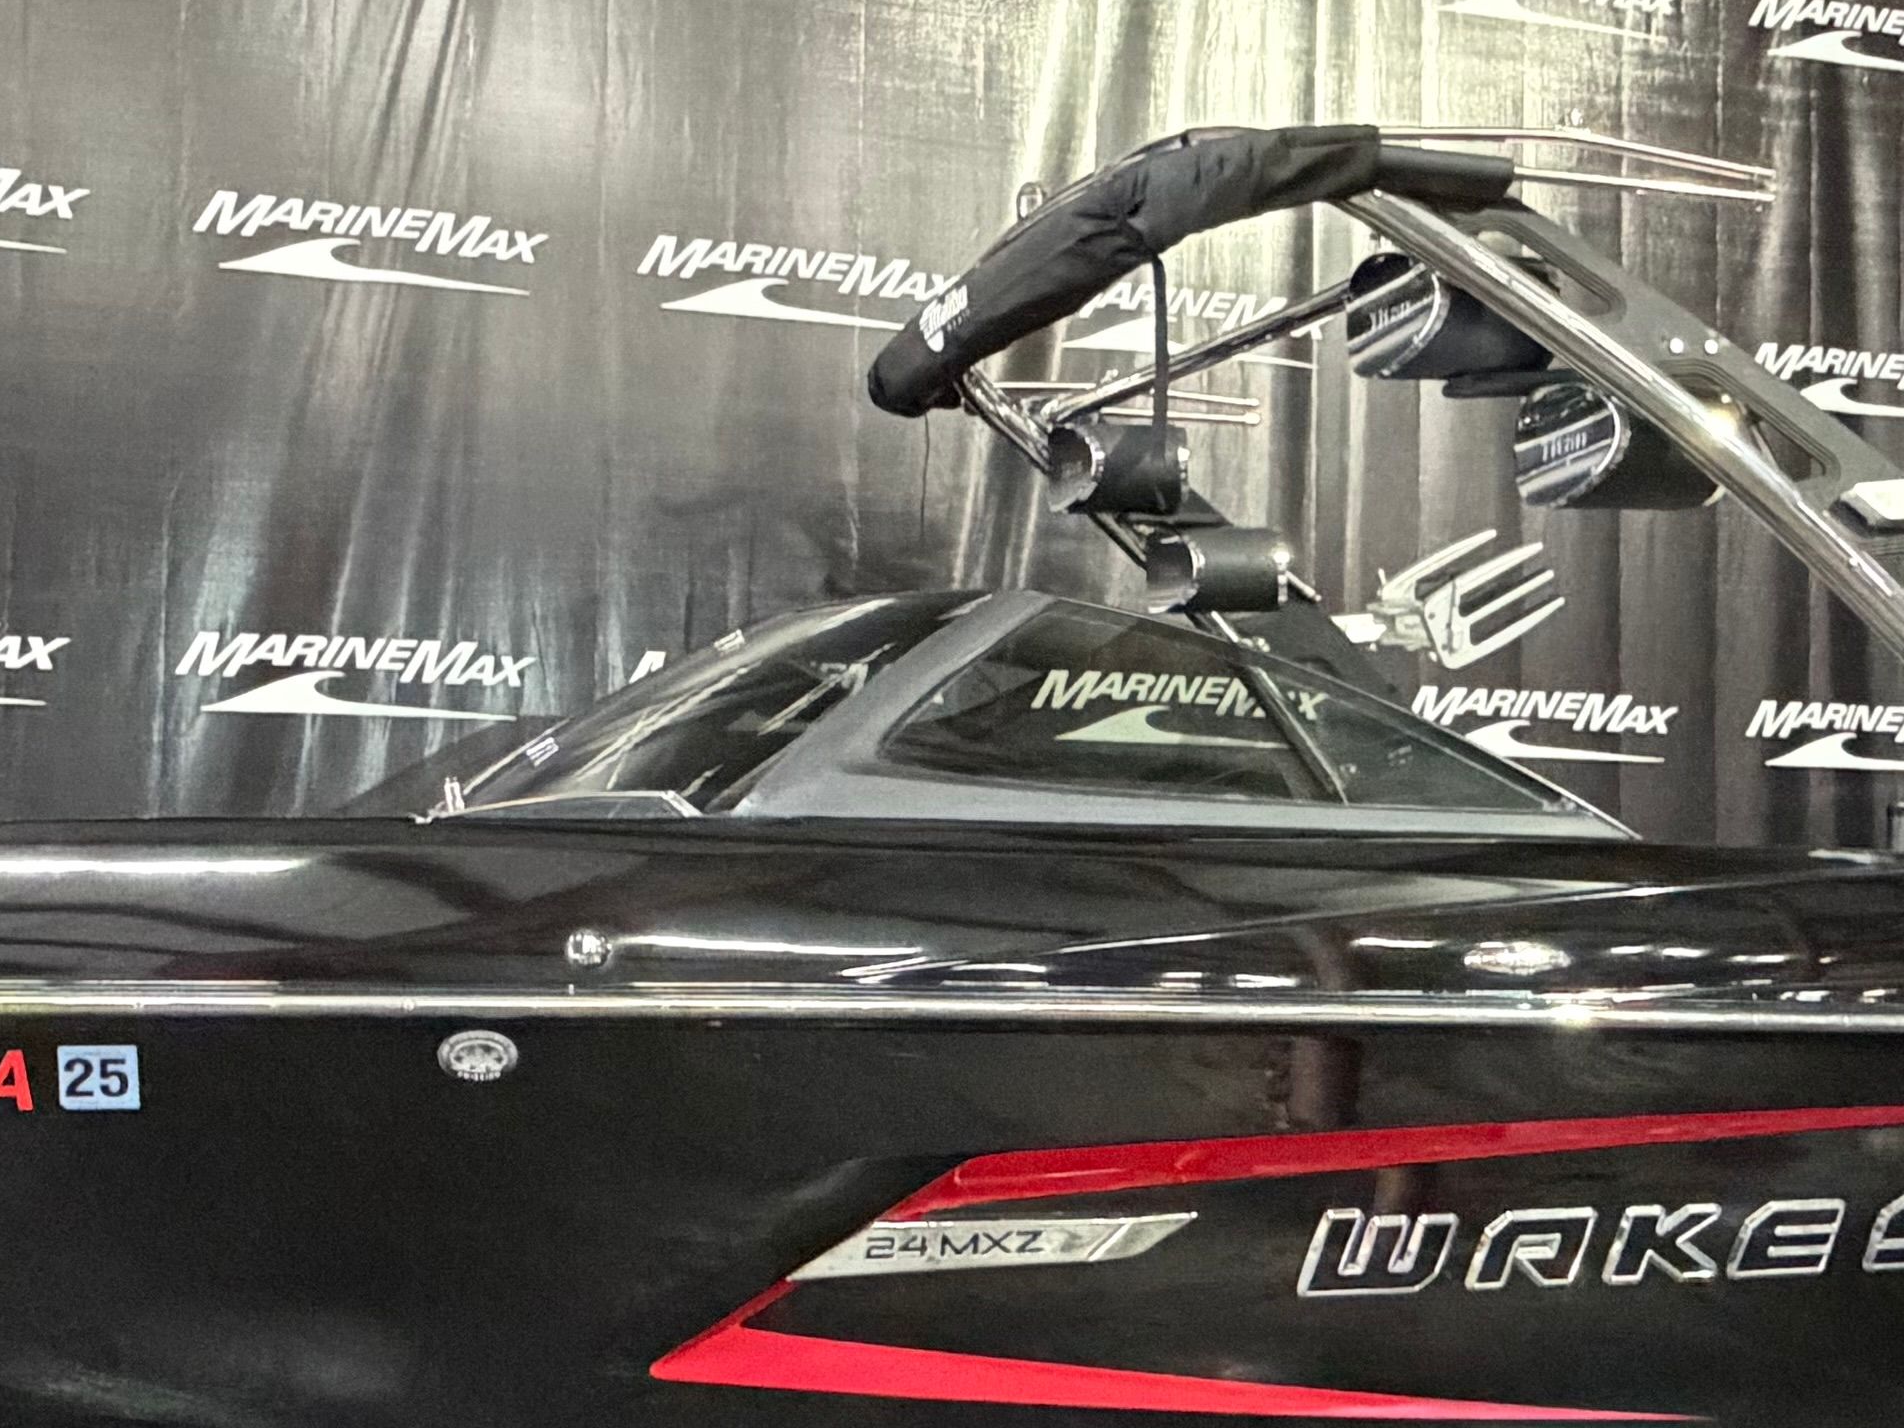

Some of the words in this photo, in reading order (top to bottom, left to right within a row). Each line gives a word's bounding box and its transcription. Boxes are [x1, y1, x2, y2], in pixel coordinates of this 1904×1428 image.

[193, 189, 549, 265] MARINEMAX
[637, 234, 961, 302] MARINEMAX
[174, 630, 536, 690] MARINEMAX
[1030, 668, 1330, 721] MARINEMX
[1411, 685, 1679, 735] MARINEMAX
[63, 1057, 130, 1098] 25
[864, 1233, 928, 1260] 24
[940, 1229, 1048, 1258] MXZ
